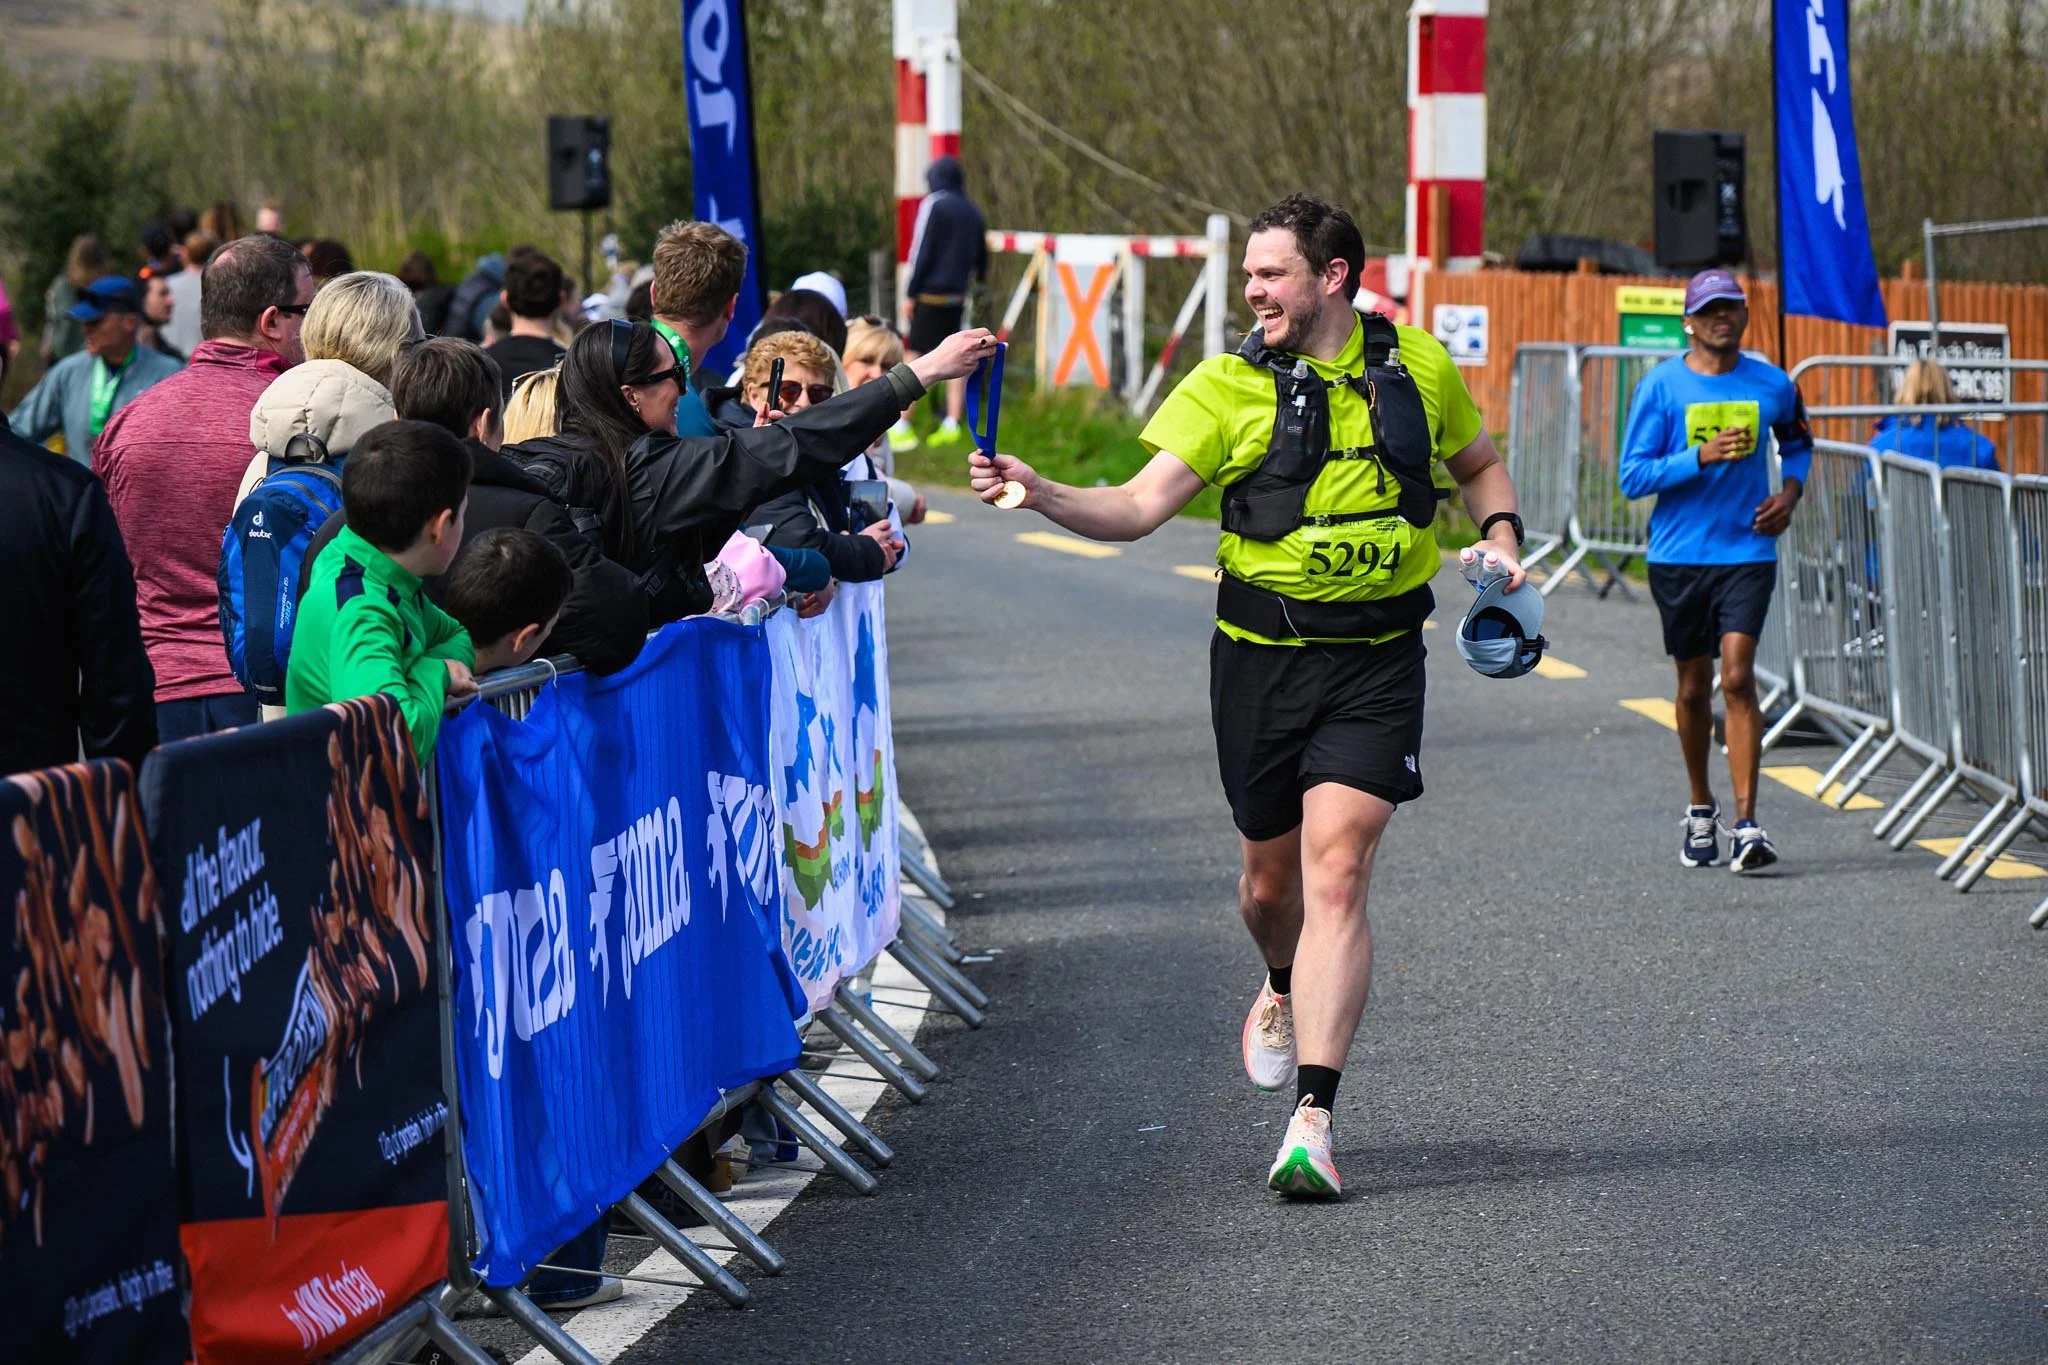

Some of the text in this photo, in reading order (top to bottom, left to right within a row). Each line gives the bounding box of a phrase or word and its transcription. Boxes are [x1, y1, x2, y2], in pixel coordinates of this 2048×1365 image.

[249, 529, 272, 539] deuter
[1307, 541, 1401, 577] 5294
[196, 843, 220, 918] the
[187, 880, 284, 1021] nothing to hide.
[326, 1259, 386, 1319] today.
